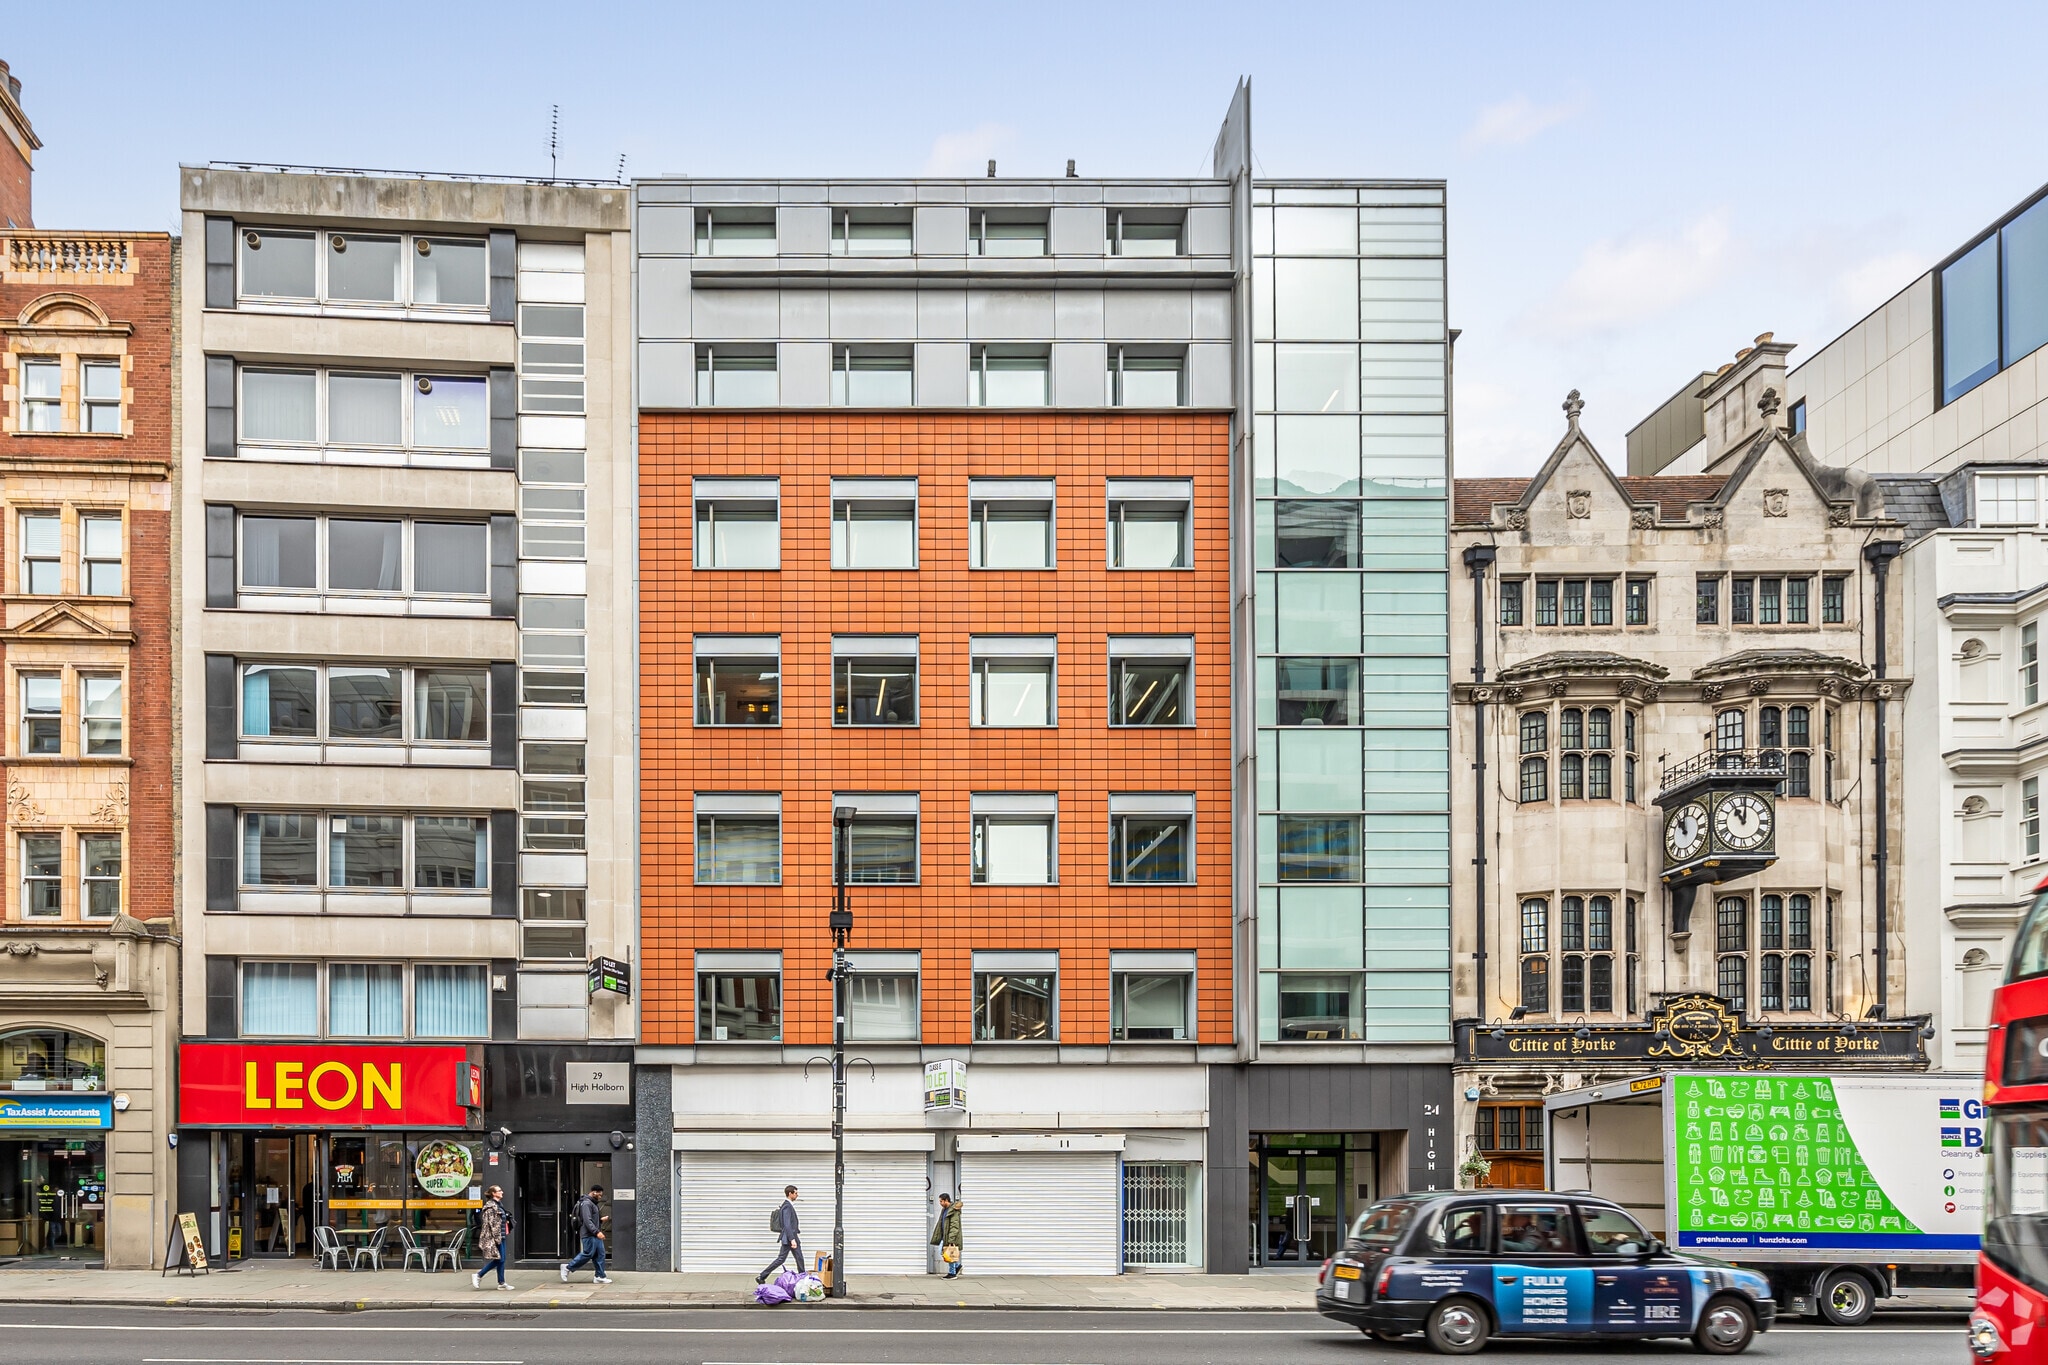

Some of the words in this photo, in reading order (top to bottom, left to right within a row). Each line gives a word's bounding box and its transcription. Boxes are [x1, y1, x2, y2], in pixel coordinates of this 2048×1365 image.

[1509, 1038, 1549, 1052] Cittie
[1553, 1038, 1566, 1052] of
[1571, 1037, 1616, 1054] Yorke
[1772, 1037, 1812, 1051] Cittie
[1816, 1037, 1830, 1050] of
[1834, 1036, 1880, 1053] Yorke
[470, 1068, 480, 1080] LEON
[592, 1072, 602, 1080] 29
[926, 1074, 932, 1088] TO
[934, 1072, 947, 1087] LET
[246, 1061, 402, 1110] LEON
[570, 1083, 588, 1092] High
[592, 1083, 624, 1091] Holborn
[6, 1108, 46, 1116] TaxAssist
[1424, 1104, 1440, 1116] 24
[1427, 1128, 1436, 1170] HIGH
[1941, 1150, 1972, 1158] Cleaning
[1523, 1276, 1568, 1286] FULLY
[1523, 1298, 1568, 1306] HOMES
